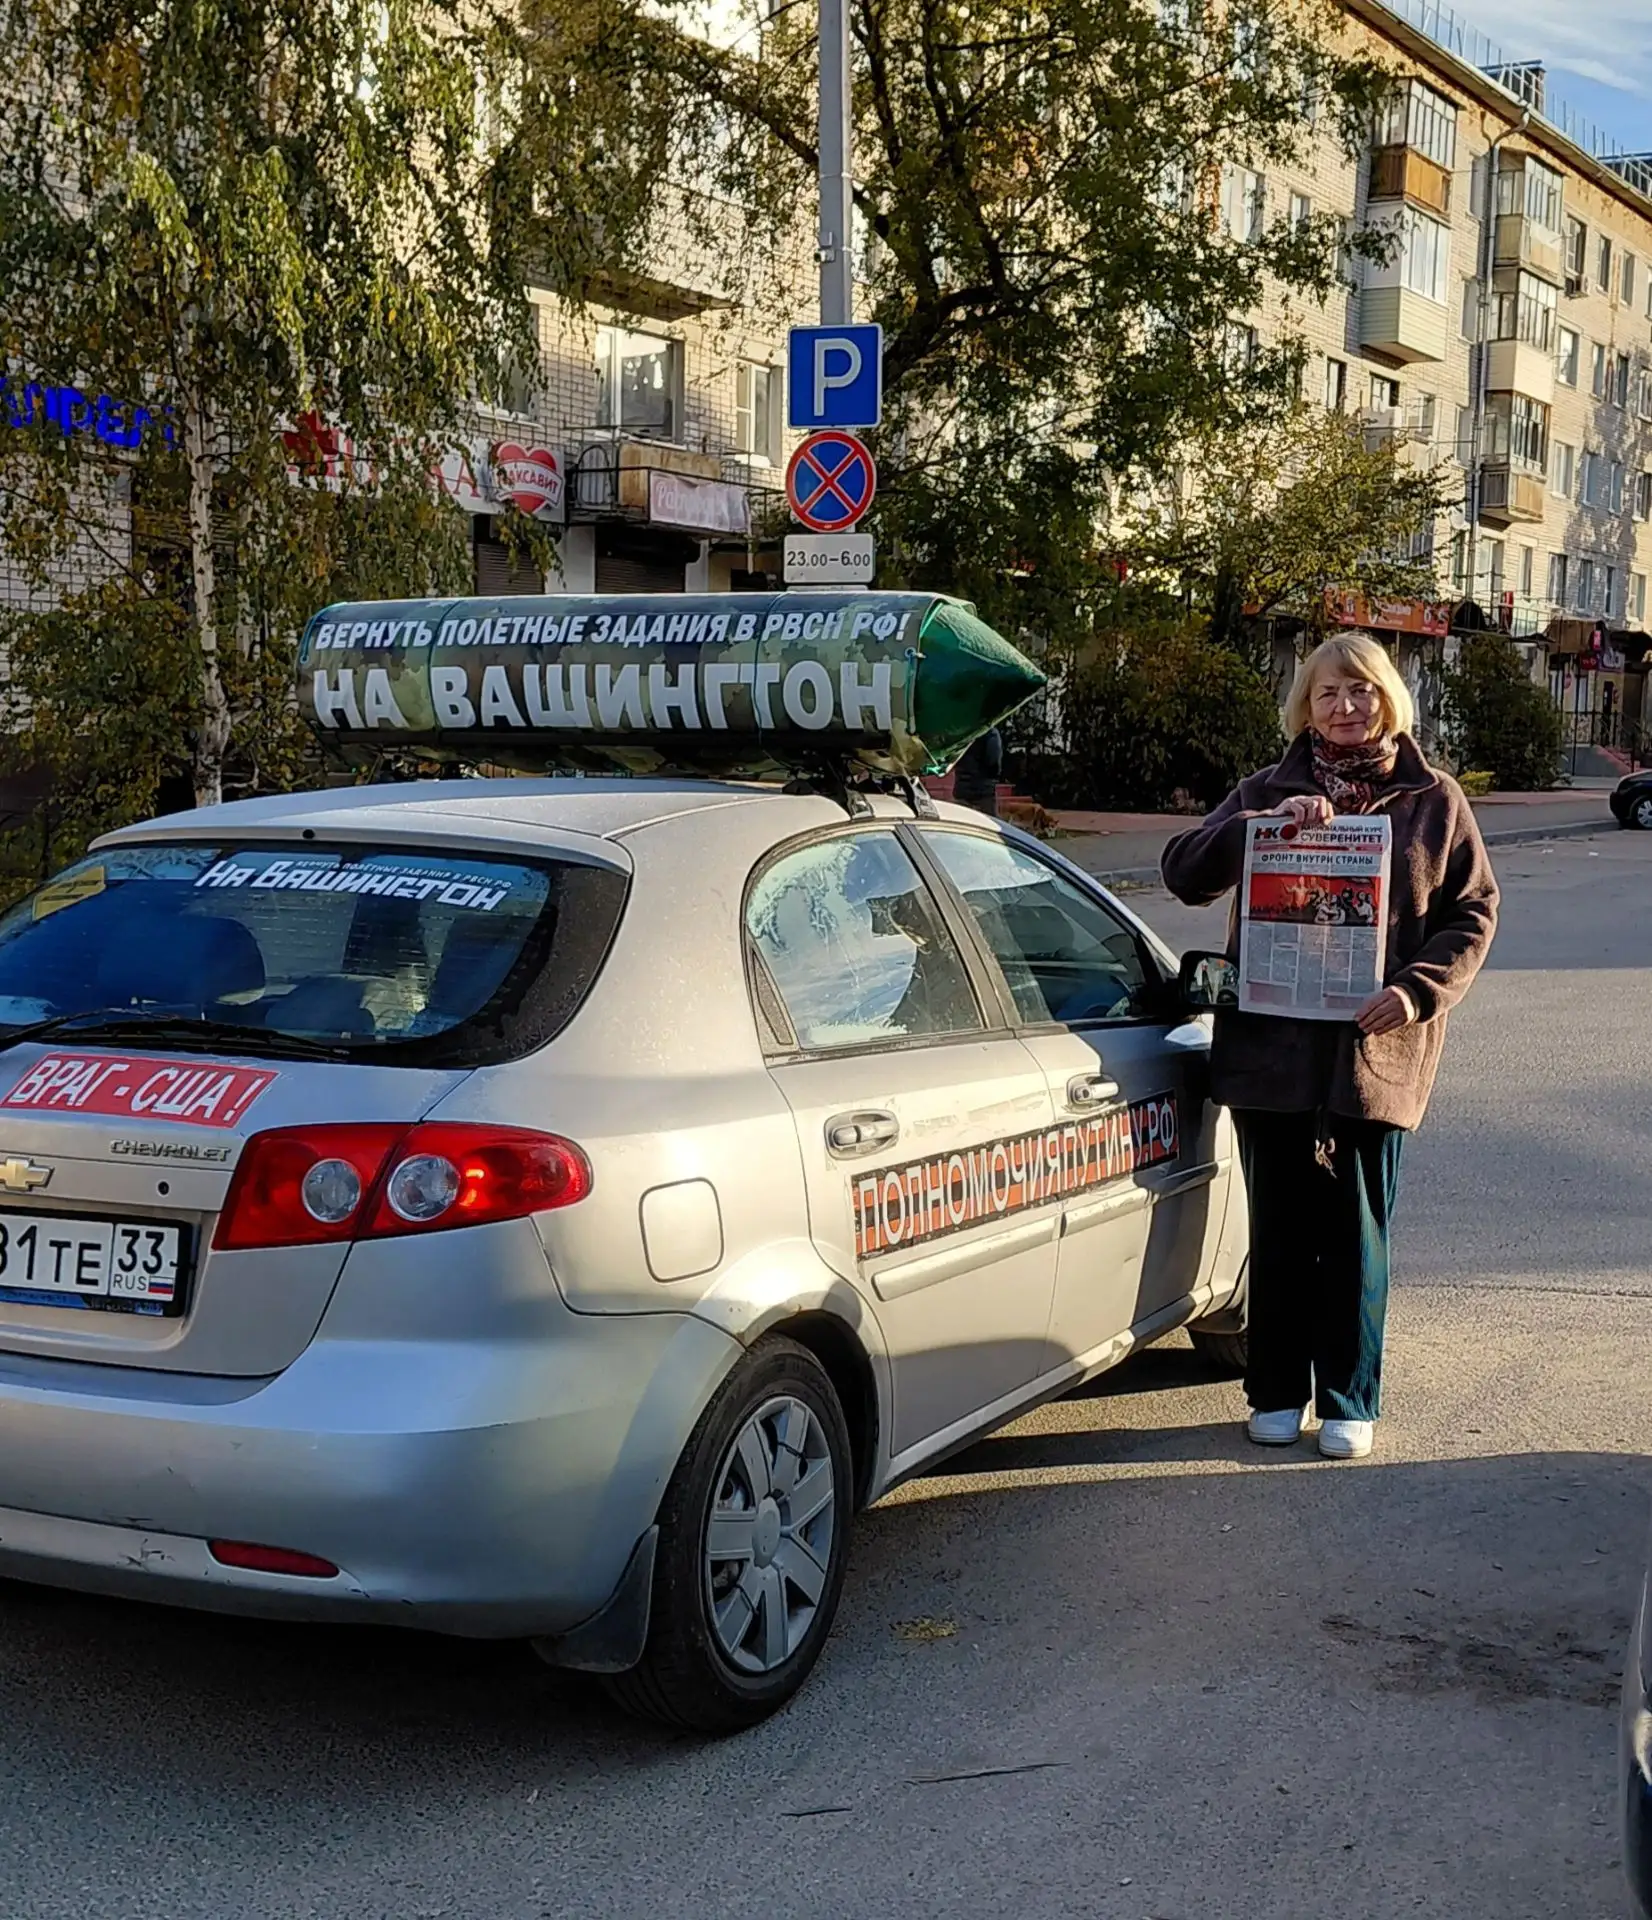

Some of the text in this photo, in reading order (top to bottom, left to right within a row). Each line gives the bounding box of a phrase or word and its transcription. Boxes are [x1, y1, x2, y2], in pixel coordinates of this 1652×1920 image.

[813, 338, 862, 417] P
[315, 611, 912, 650] ВЕРНУТЬ ПОЛЕТНЫЕ ЗАДАНИЯ В РВСН РФ!
[313, 659, 893, 731] НА ВАШИНГТОН
[1300, 832, 1383, 844] СУВЕРЕНИТЕТ
[1261, 853, 1374, 865] ФРОНТ ВНУТРИ СТРАНЫ
[109, 1139, 232, 1162] CHEVROLET
[859, 1098, 1175, 1252] ПОЛНОМОЧИЯПУТИНУ.РФ
[118, 1229, 165, 1275] 33
[112, 1273, 147, 1291] RUS
